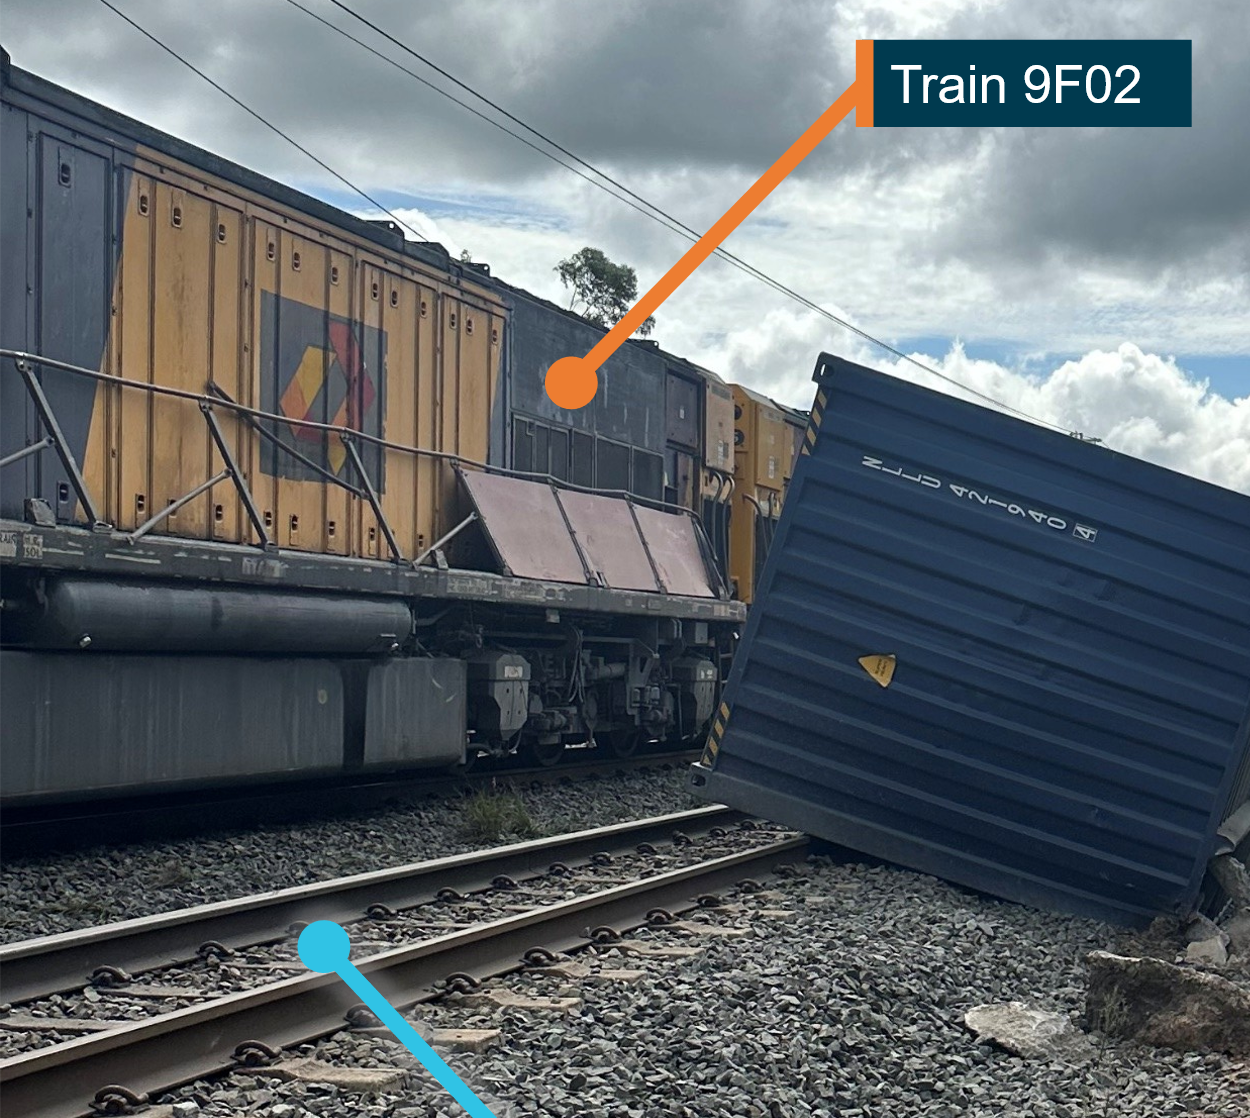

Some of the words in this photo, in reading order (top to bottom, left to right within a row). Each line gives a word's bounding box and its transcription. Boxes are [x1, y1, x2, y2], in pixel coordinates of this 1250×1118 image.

[861, 456, 940, 488] NLLU
[949, 485, 1067, 529] 421940
[1076, 524, 1096, 540] 4
